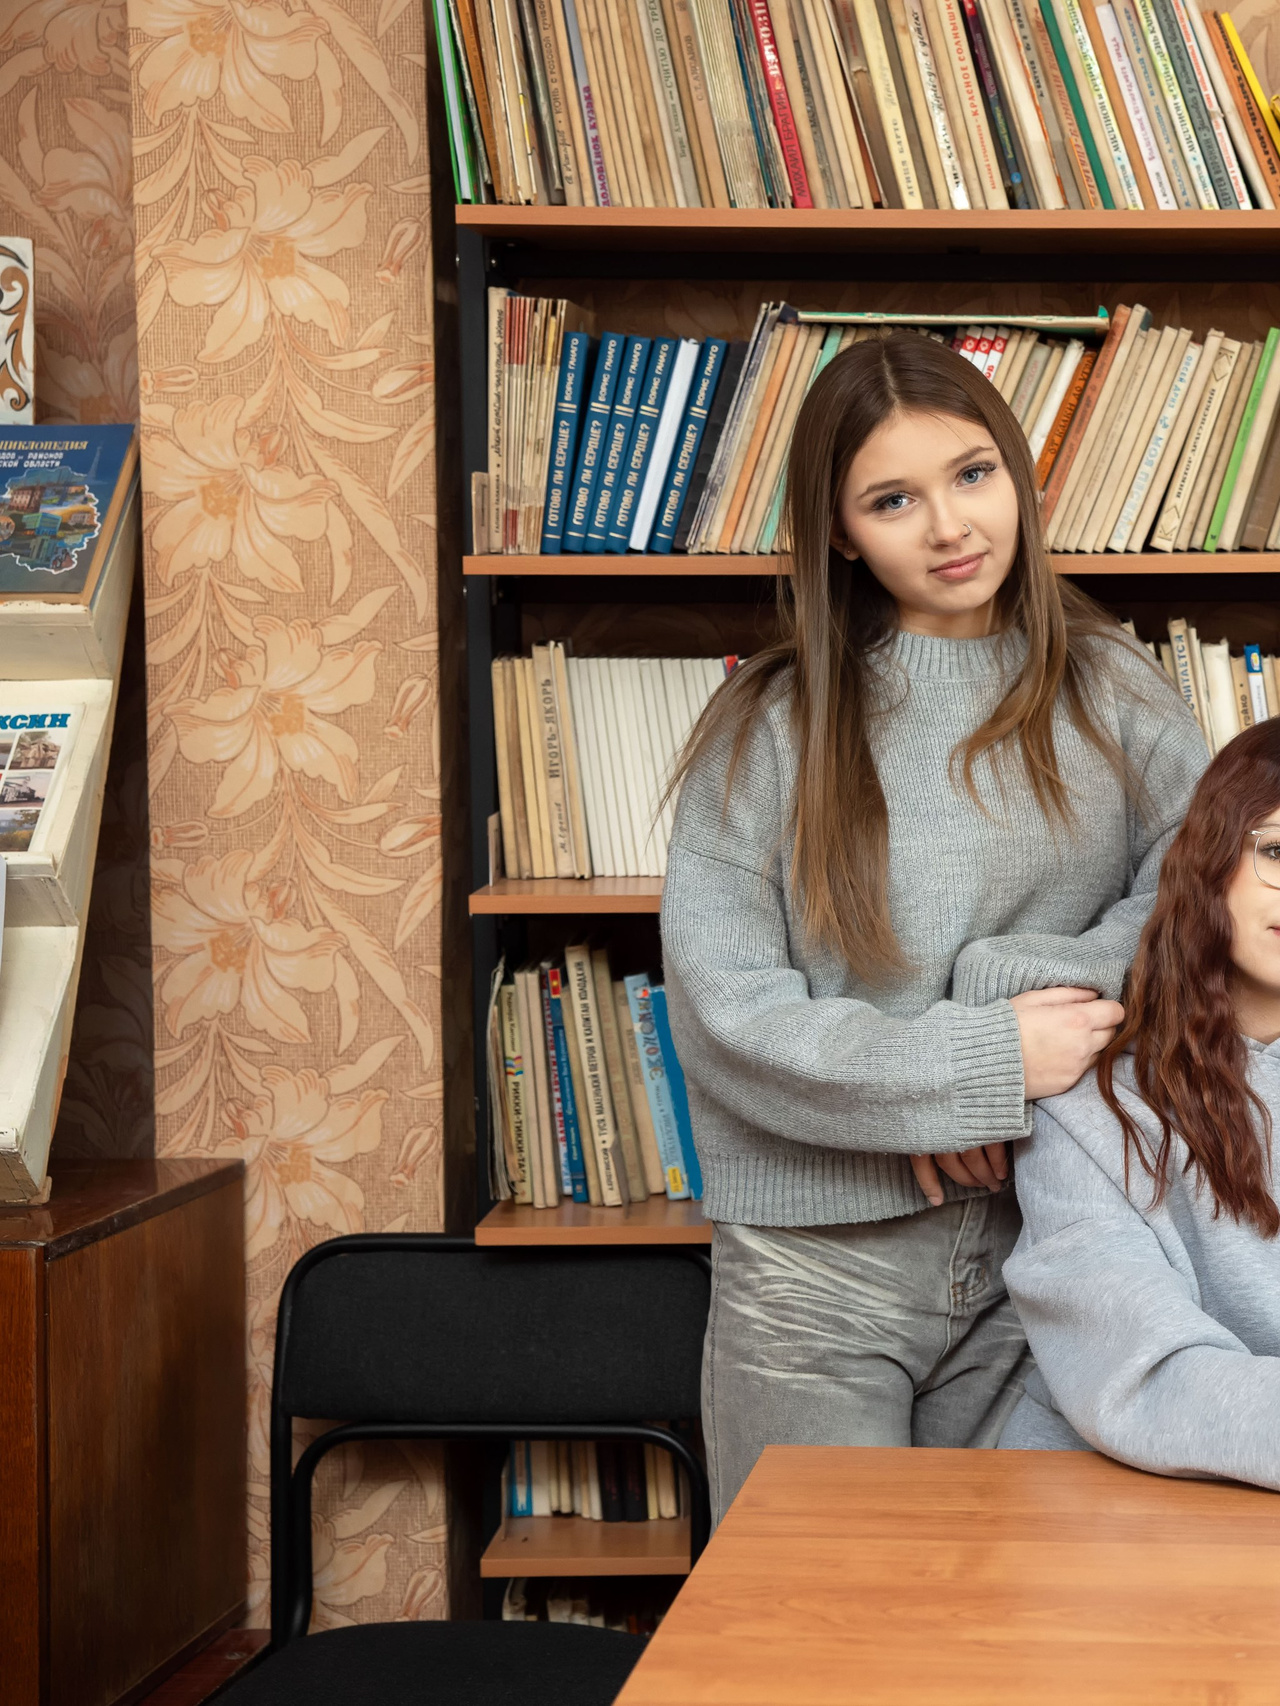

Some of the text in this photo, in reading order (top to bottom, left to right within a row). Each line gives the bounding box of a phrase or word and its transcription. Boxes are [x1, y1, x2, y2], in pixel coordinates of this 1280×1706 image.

[654, 27, 664, 42] ДО
[658, 47, 673, 88] СЧИТАЮ
[959, 64, 979, 116] КРАСНОЕ
[552, 87, 562, 114] КОНЬ
[774, 91, 806, 199] МИХАИЛ БРАГИН
[1202, 137, 1222, 175] ВОРОНИН
[1265, 156, 1278, 175] НА
[1215, 176, 1233, 207] СЕРГЕЙ
[547, 337, 579, 527] ГОТОВО ЛИ СЕРДЦЕ? БОРИС ГАНАГО
[572, 338, 617, 525] ГОТОВО ЛИ СЕРДЦЕ? БОРИС ГАНАГО
[593, 342, 642, 528] ГОТОВО ЛИ СЕРДЦЕ? БОРИС ГАНАГО
[615, 342, 669, 527] ГОТОВО ЛИ СЕРДЦЕ? БОРИС ГАНАГО
[661, 344, 719, 527] ГОТОВО ЛИ СЕРДЦЕ? БОРИС ГАНАГО
[1142, 434, 1164, 468] МОЯ
[1174, 387, 1216, 498] ВИКТОР ДРАГУНСКИЙ
[1113, 470, 1150, 542] ПЕСЕНКА
[1173, 634, 1195, 710] СЧИТАЕТСЯ
[541, 678, 559, 778] ИГОРЬ-ЯКОРЬ
[579, 1002, 594, 1037] КАПИТАН
[585, 1044, 599, 1072] ПЕТРОВ
[587, 1072, 605, 1116] МАЛЕНЬКИЙ
